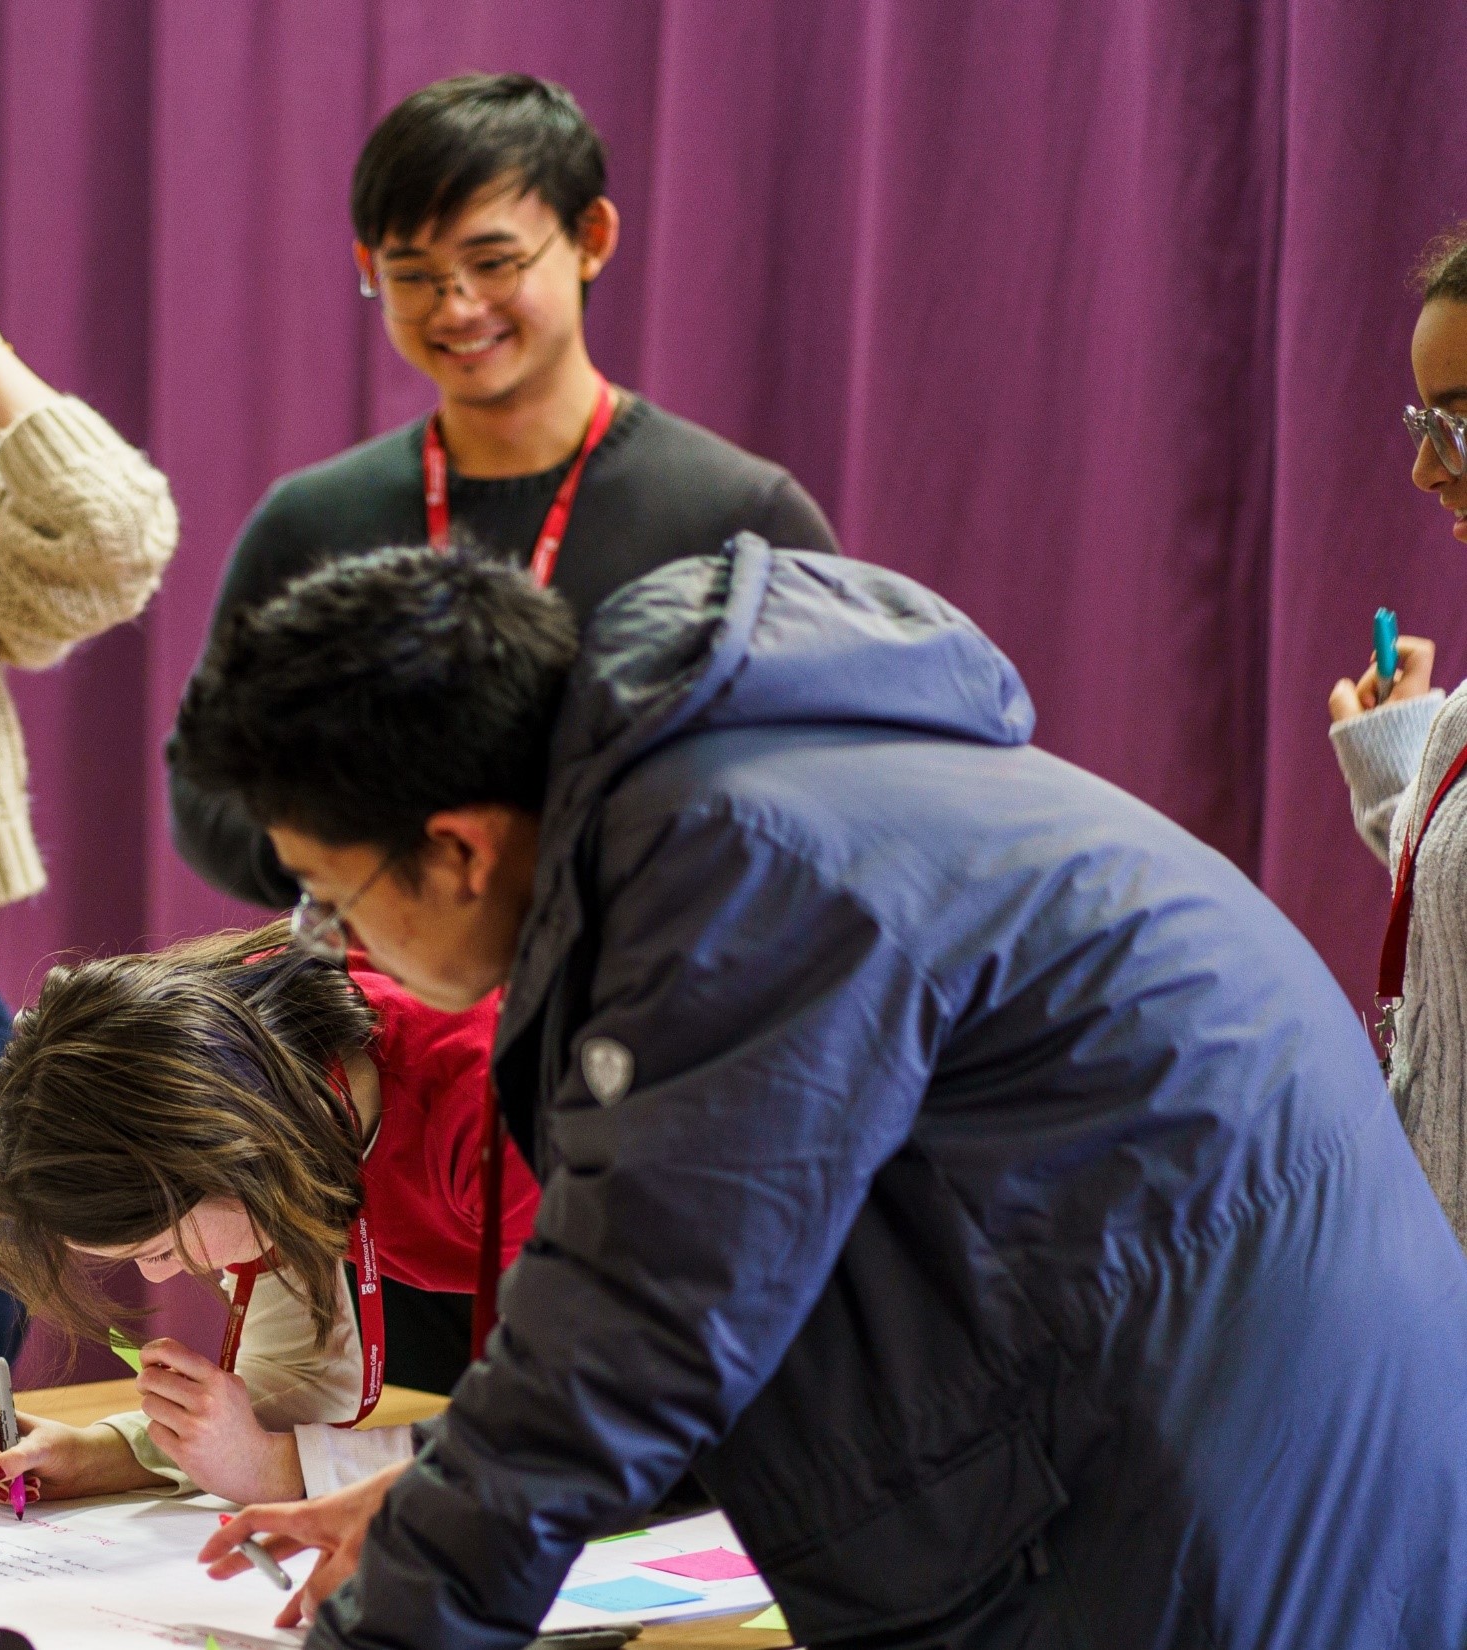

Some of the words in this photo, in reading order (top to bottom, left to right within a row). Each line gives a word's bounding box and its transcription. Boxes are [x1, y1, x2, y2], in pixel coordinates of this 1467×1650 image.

[359, 1217, 368, 1243] College
[363, 1242, 373, 1282] Stephenson
[370, 1344, 379, 1366] College
[368, 1365, 377, 1397] Stephenson
